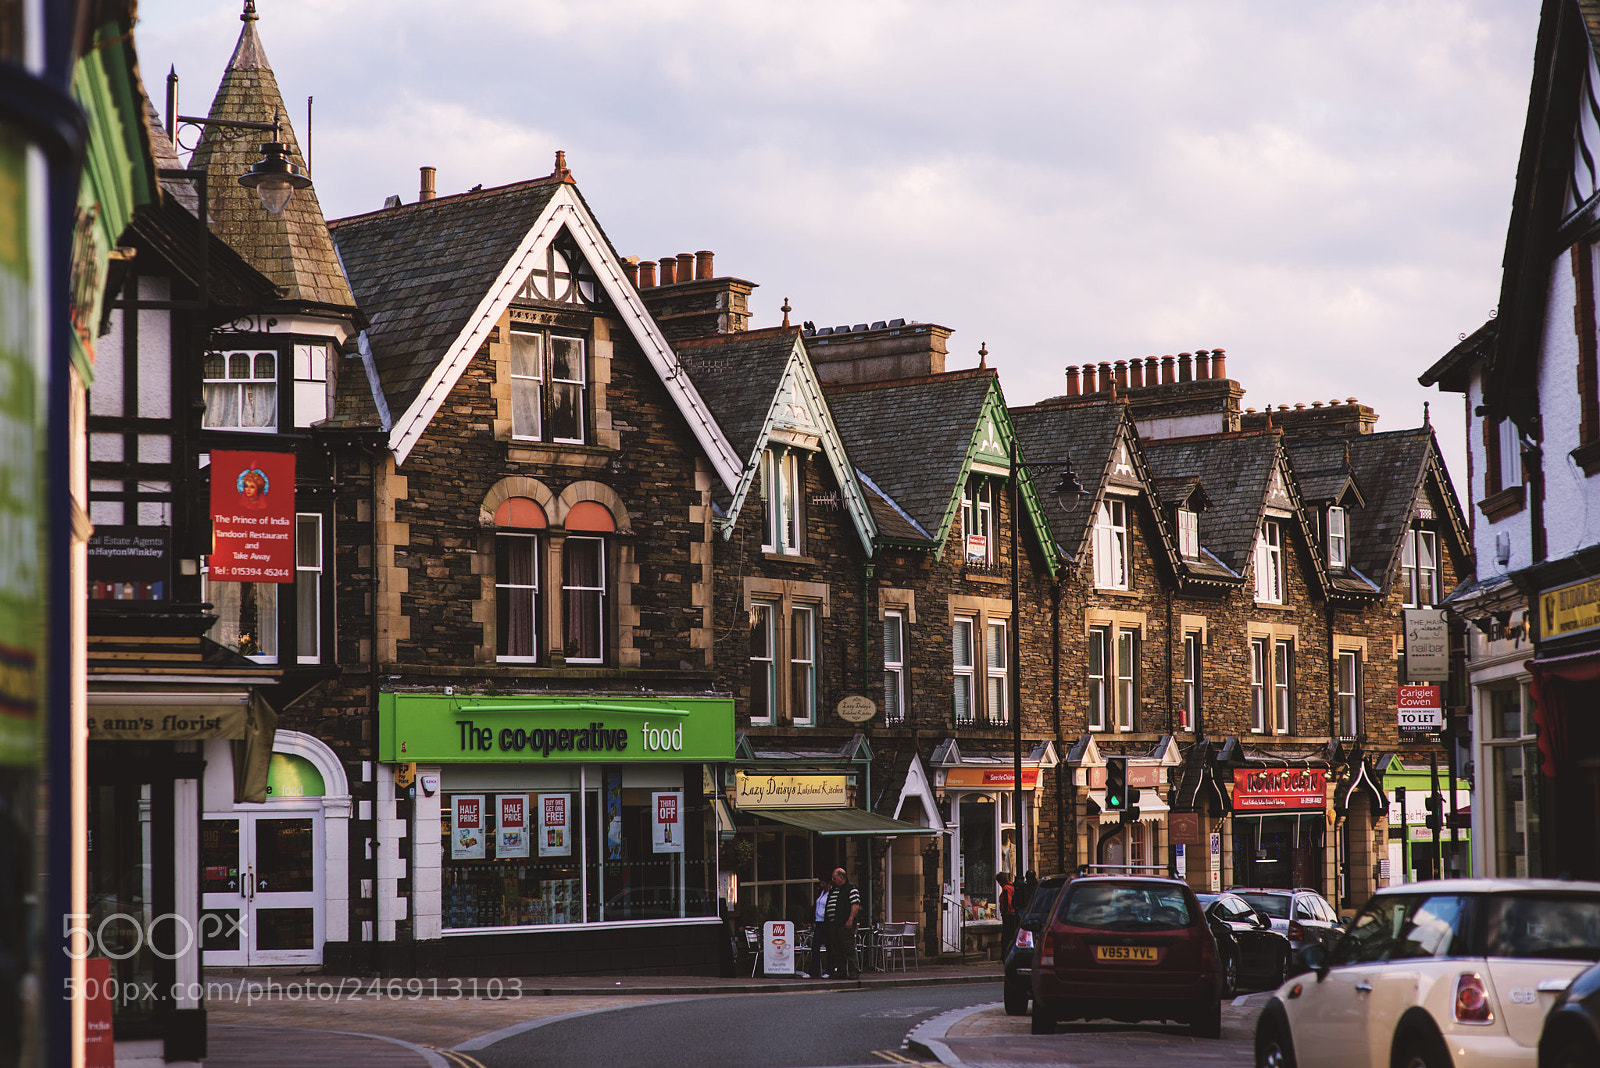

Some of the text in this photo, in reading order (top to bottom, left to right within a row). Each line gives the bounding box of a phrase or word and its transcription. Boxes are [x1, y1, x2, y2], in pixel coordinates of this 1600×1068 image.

[214, 515, 290, 525] The Prince of India
[216, 530, 288, 540] Tandoori Restaurant
[104, 536, 131, 545] Estate
[134, 537, 163, 548] Agents
[88, 548, 164, 558] nHaytonWinkley
[232, 552, 270, 562] Take Away
[231, 567, 261, 575] 015394
[264, 568, 289, 576] 45244
[1412, 644, 1444, 652] nail bar
[1400, 698, 1431, 706] Cowen
[104, 717, 154, 730] ann's
[162, 715, 221, 730] florist
[1401, 714, 1434, 723] TO LET
[456, 720, 682, 757] The co-operative food
[282, 785, 303, 796] food
[741, 776, 764, 803] Lazy
[766, 776, 796, 802] Daisy's
[460, 805, 477, 814] HALF
[504, 804, 521, 813] HALF
[660, 808, 675, 819] OFF
[460, 814, 477, 822] PRICE
[504, 813, 521, 821] PRICE
[546, 812, 564, 821] FREE
[1392, 810, 1414, 820] Tele
[774, 925, 784, 935] illy
[1102, 948, 1153, 958] V853 YVL
